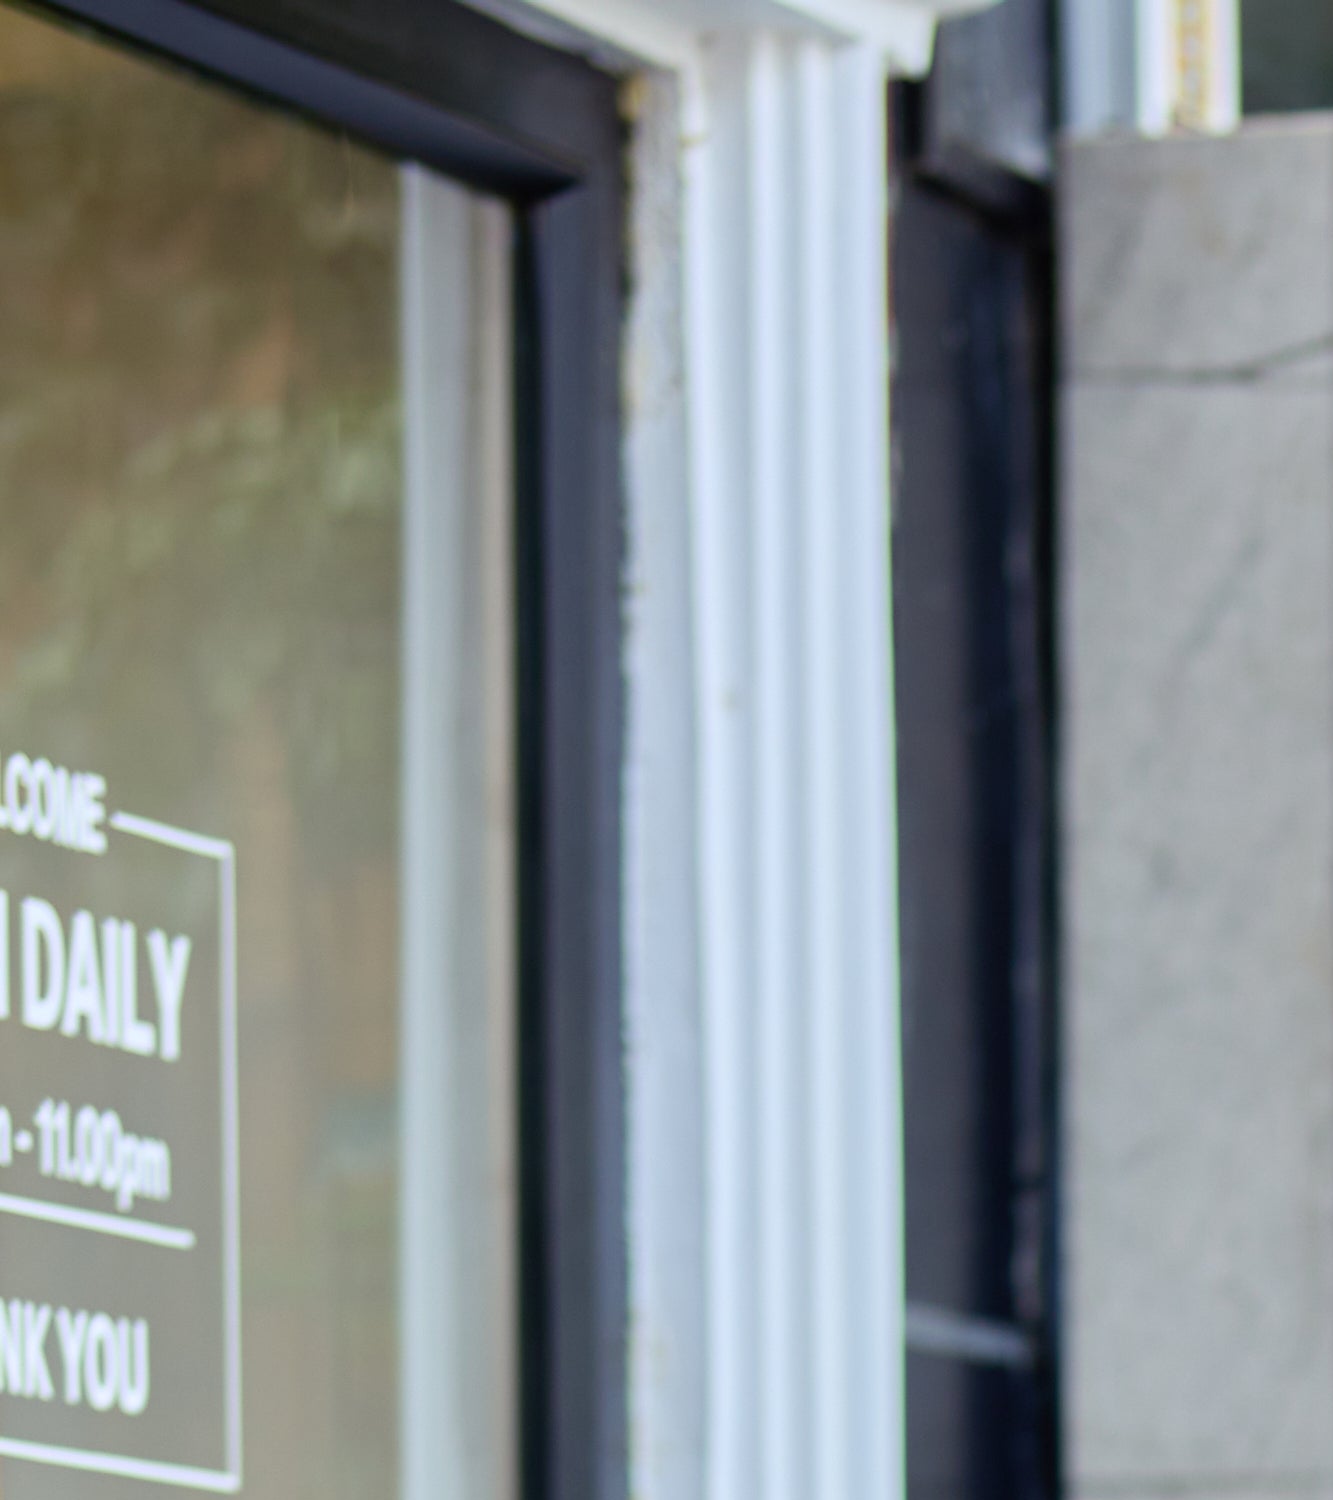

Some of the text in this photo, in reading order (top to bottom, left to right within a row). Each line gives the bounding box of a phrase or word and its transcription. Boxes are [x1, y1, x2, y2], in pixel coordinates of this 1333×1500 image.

[0, 752, 107, 855] COME
[21, 896, 192, 1062] DAILY
[55, 1307, 149, 1416] YOU
